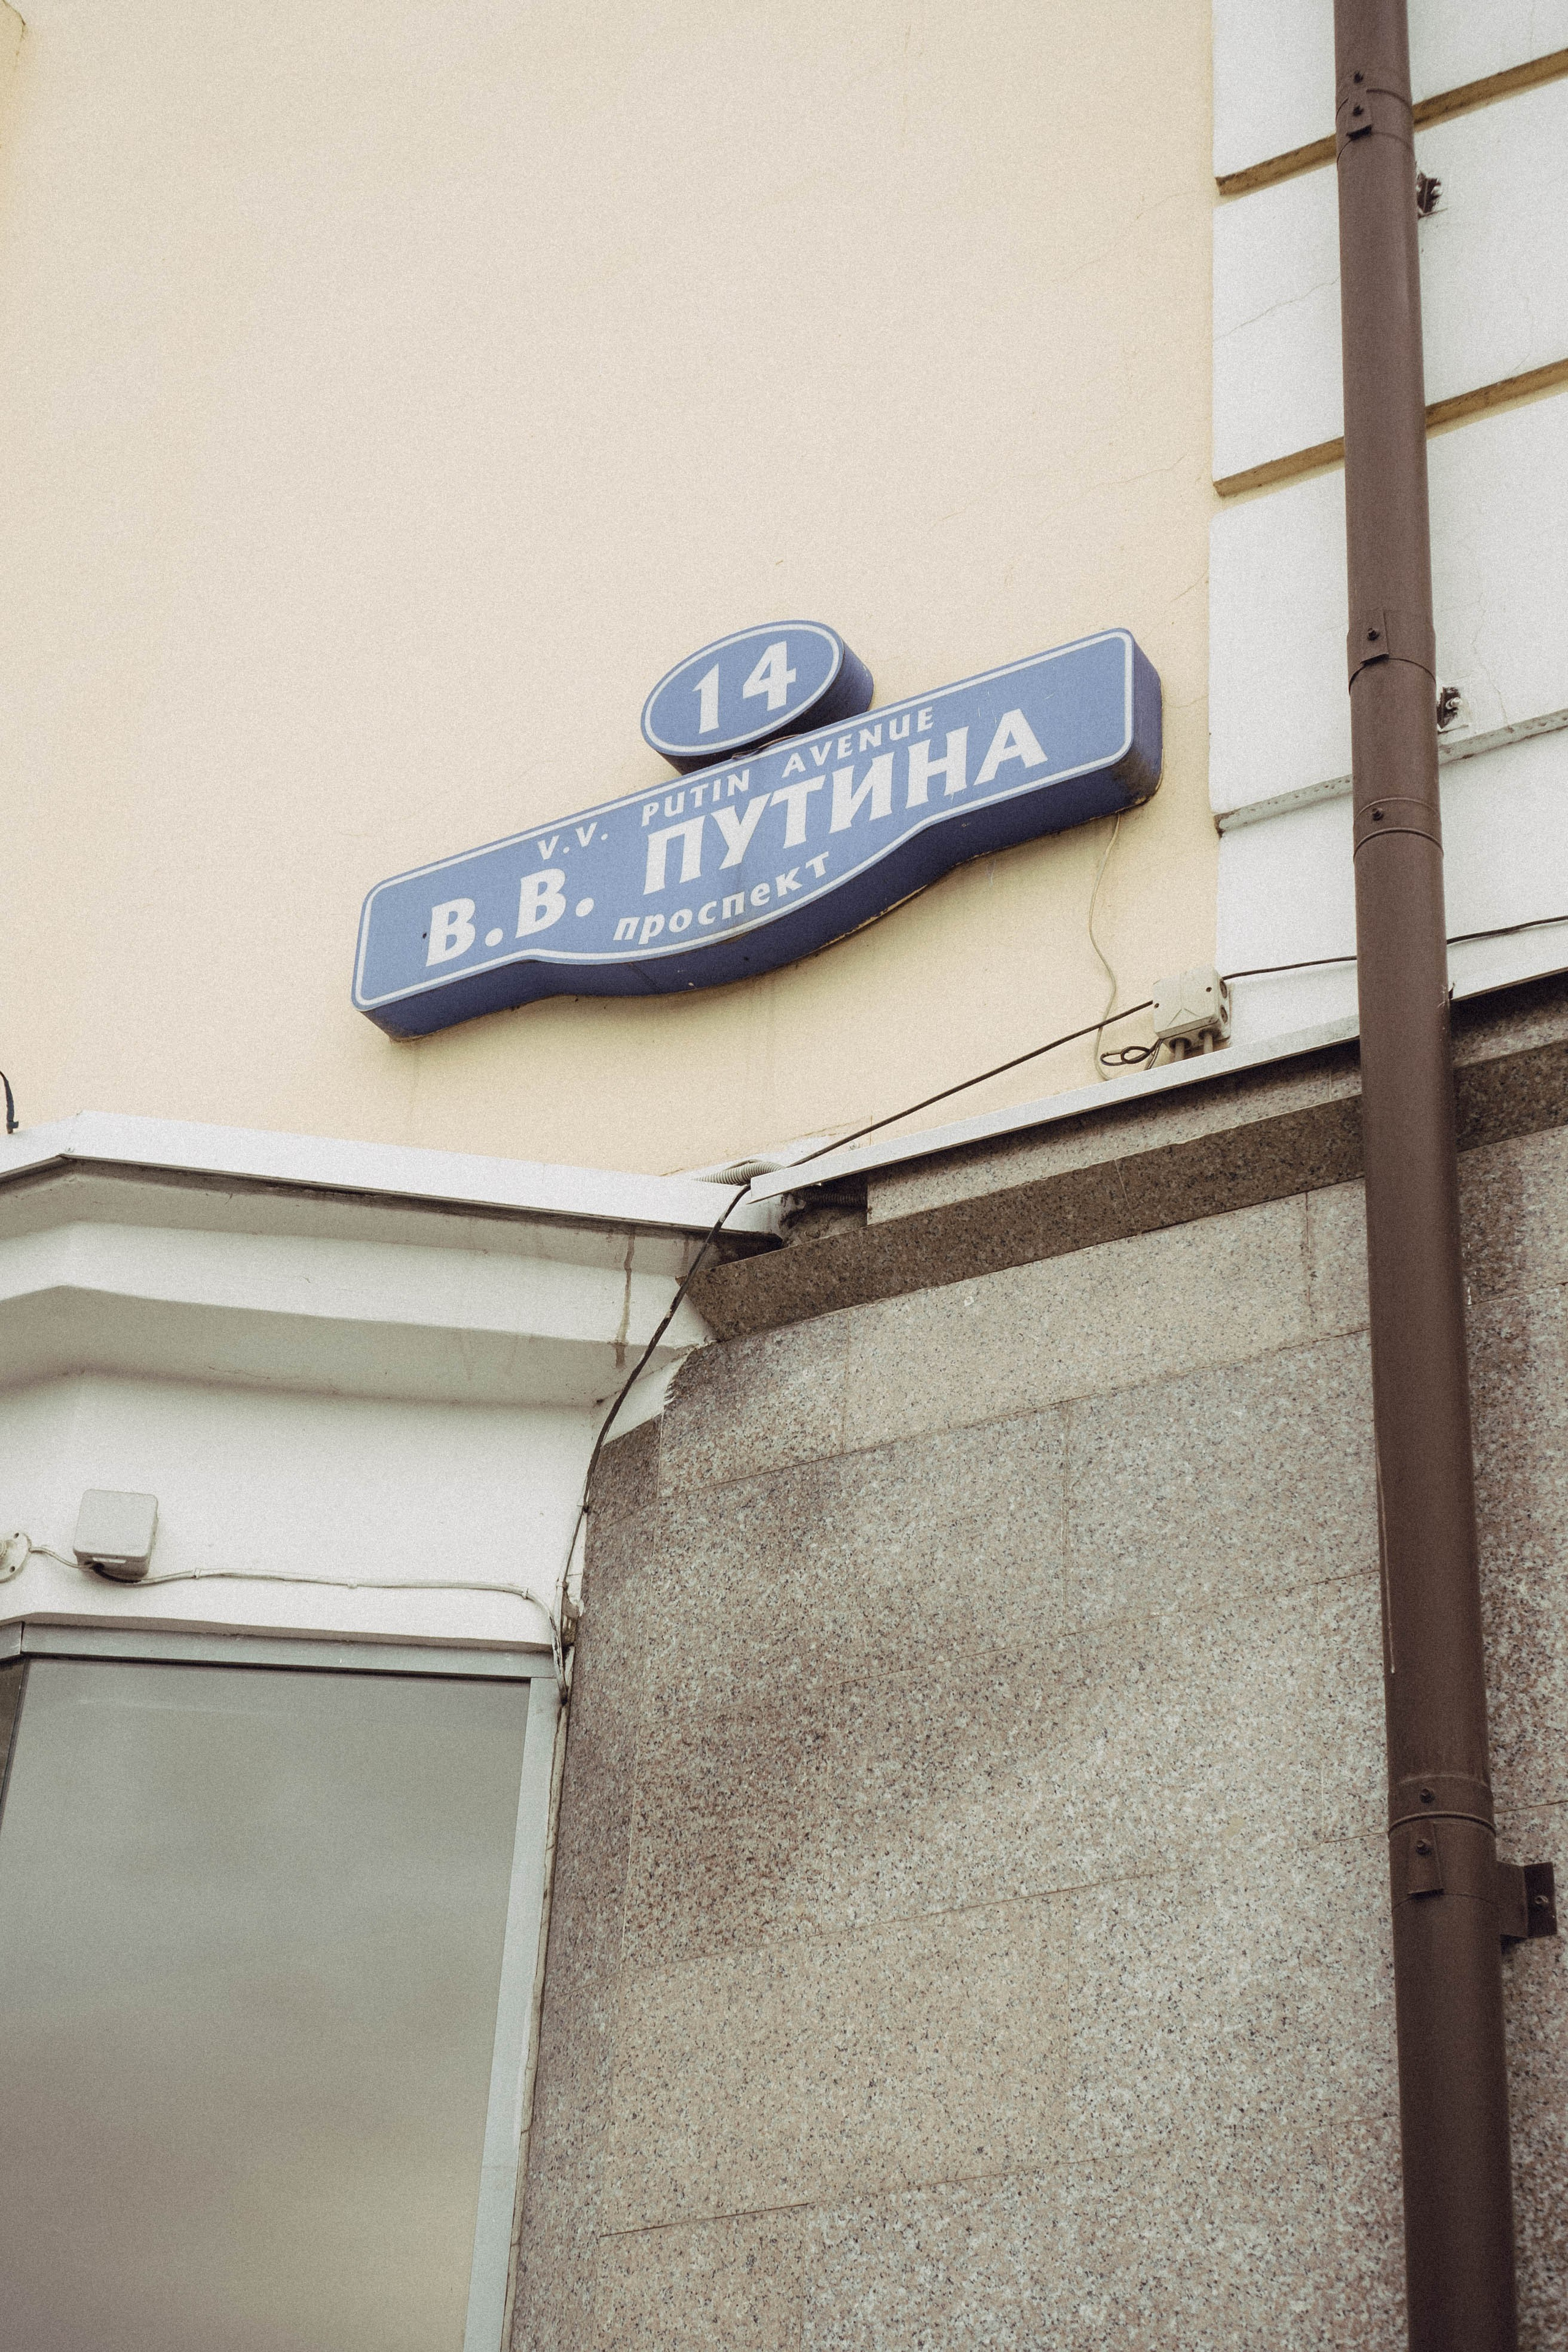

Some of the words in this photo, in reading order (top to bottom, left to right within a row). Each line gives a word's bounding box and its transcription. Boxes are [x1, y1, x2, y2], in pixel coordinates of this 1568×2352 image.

[693, 640, 796, 734] 14
[641, 769, 750, 827] PUTIN
[782, 707, 934, 778] AVENUE
[643, 708, 1048, 895] ПУТИНА
[612, 851, 830, 944] проспект
